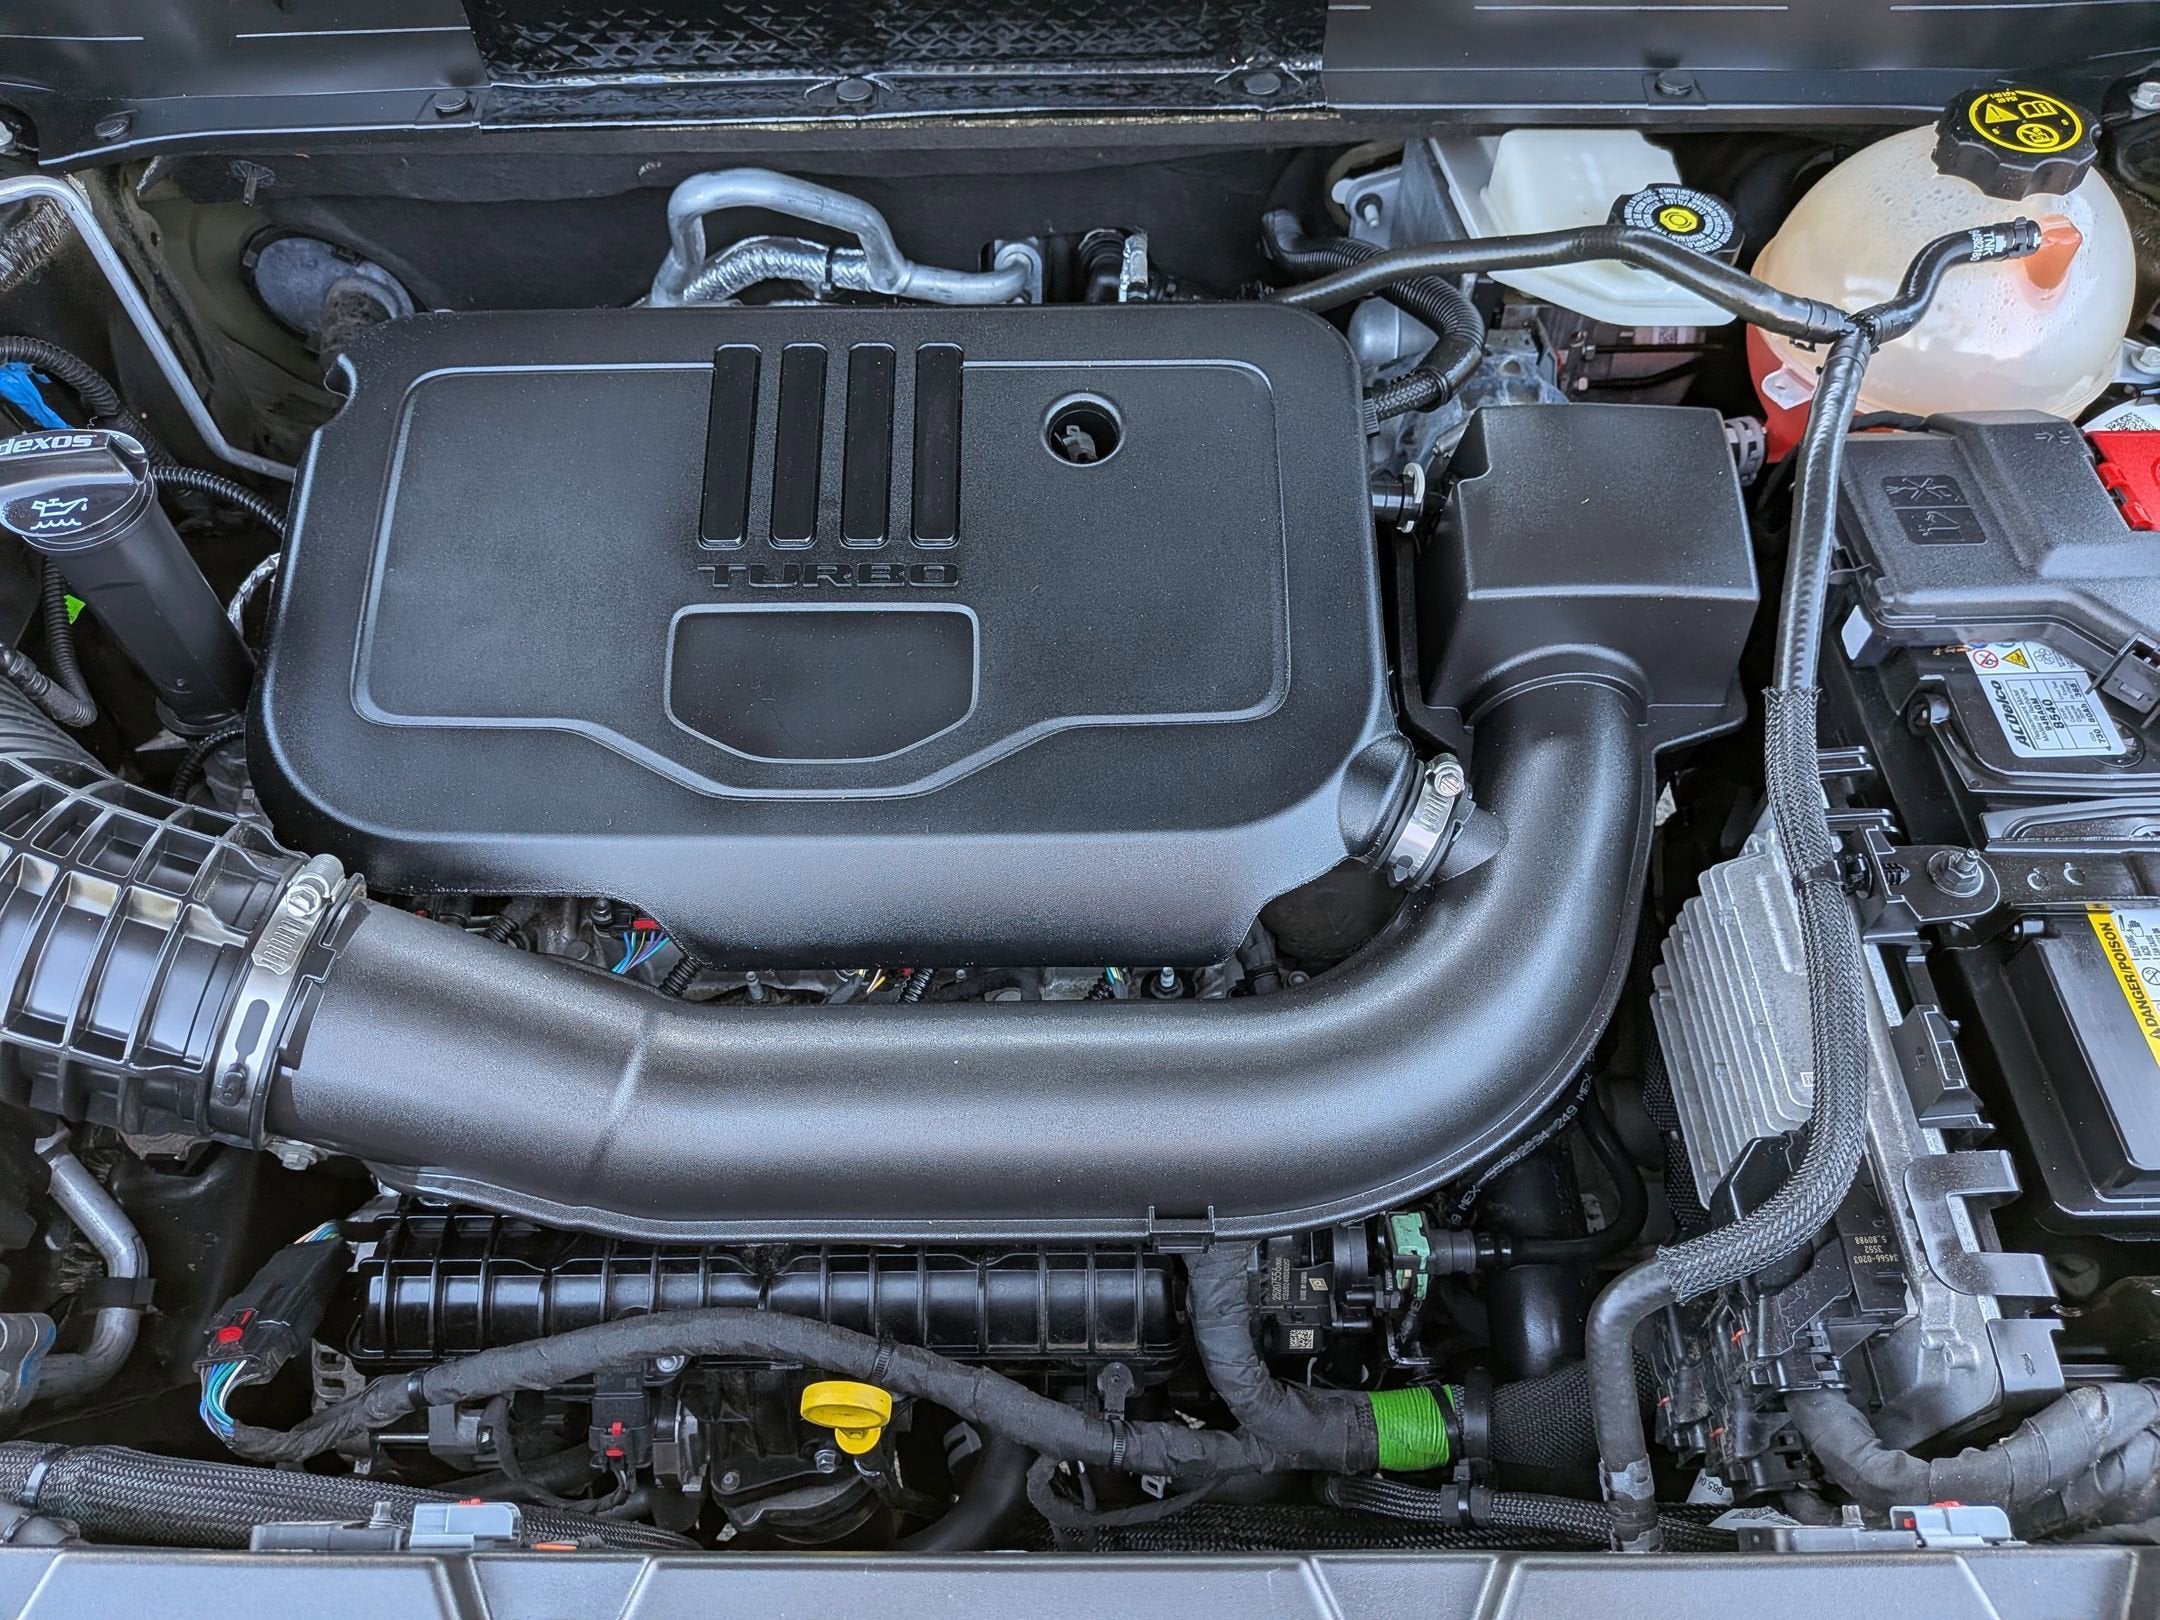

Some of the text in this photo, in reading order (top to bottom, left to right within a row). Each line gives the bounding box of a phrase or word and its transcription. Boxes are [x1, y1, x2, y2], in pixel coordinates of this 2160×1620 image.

[1983, 230, 1996, 257] TNK
[698, 563, 959, 588] TURBO
[1990, 680, 2030, 748] ACDelco
[2041, 699, 2065, 729] 8540
[2099, 921, 2158, 1028] DANGER/POISON
[1553, 1104, 1578, 1130] 249
[1576, 1072, 1593, 1101] MEX
[1457, 1184, 1481, 1211] MEX
